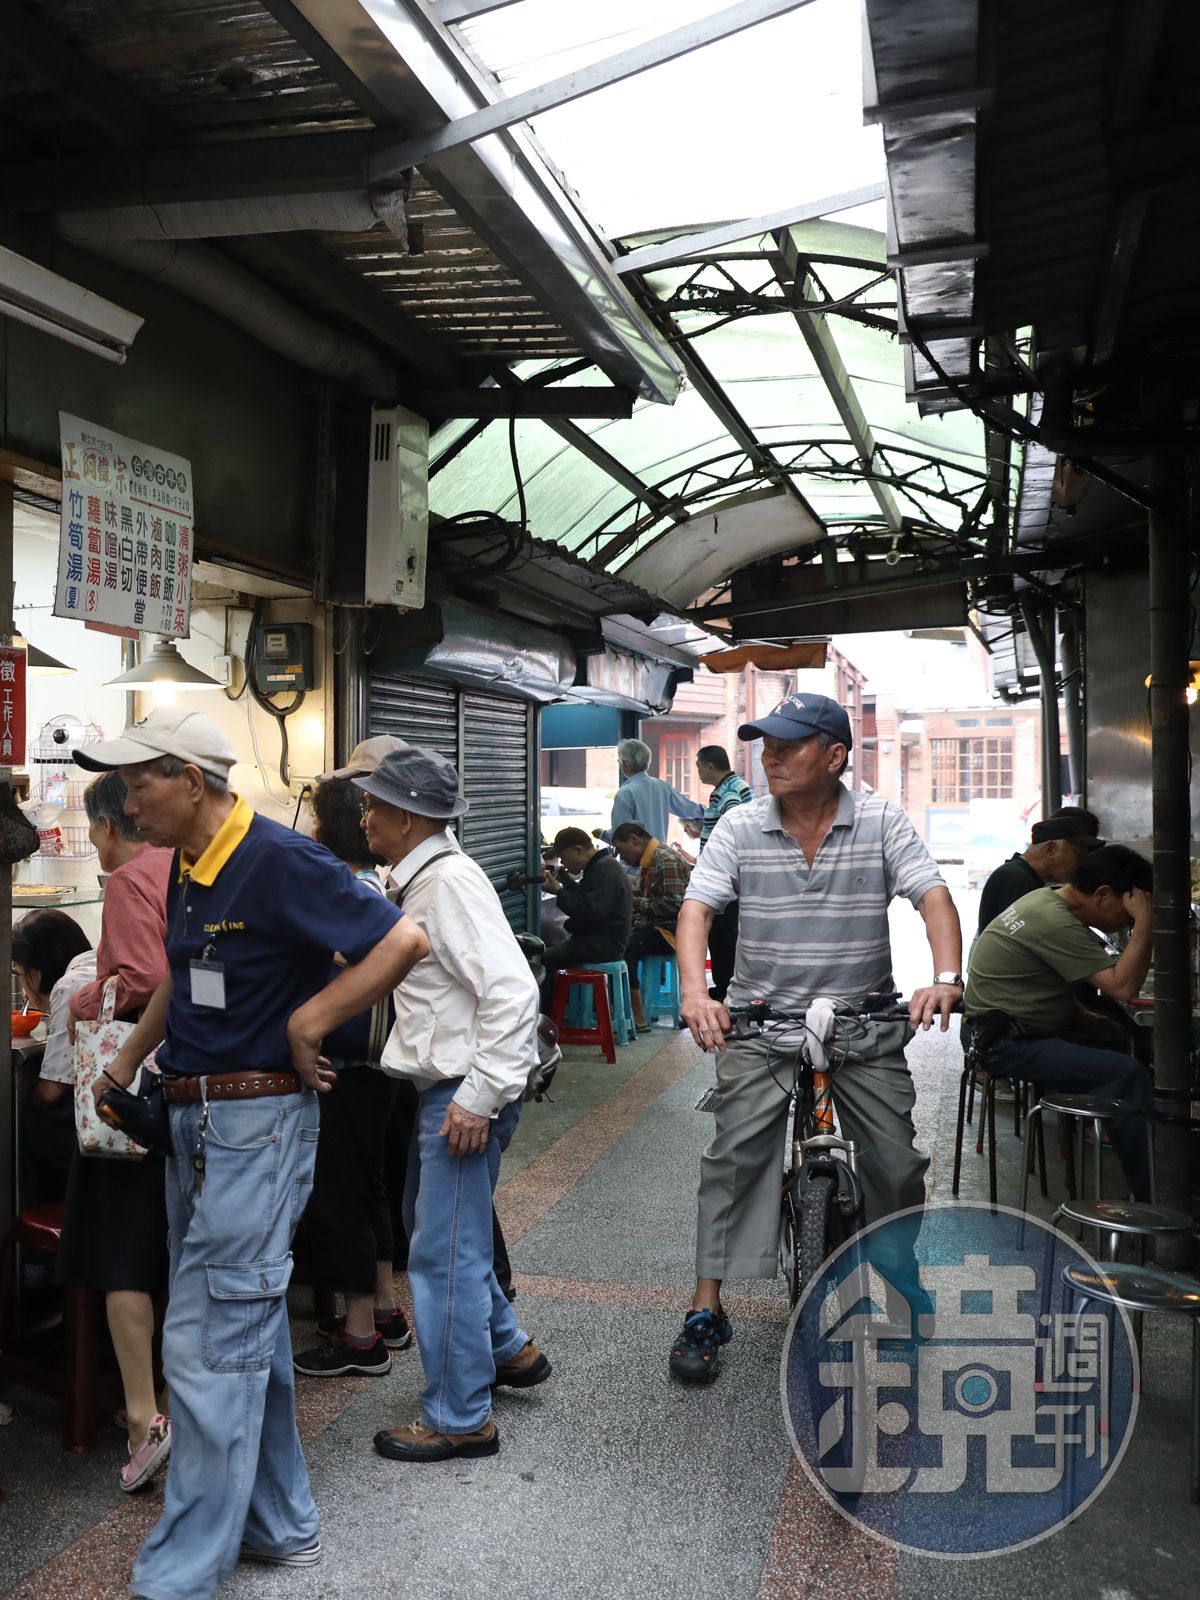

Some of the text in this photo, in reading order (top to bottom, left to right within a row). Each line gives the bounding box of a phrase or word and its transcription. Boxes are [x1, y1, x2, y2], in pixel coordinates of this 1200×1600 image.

[132, 455, 187, 494] 台灣古早味
[104, 501, 118, 590] 味噌湯
[121, 505, 133, 593] 黑白切
[134, 511, 148, 625] 外帶便當
[150, 514, 163, 600] 滷肉飯
[163, 520, 176, 603] 咖哩飯
[174, 523, 190, 632] 清粥小菜
